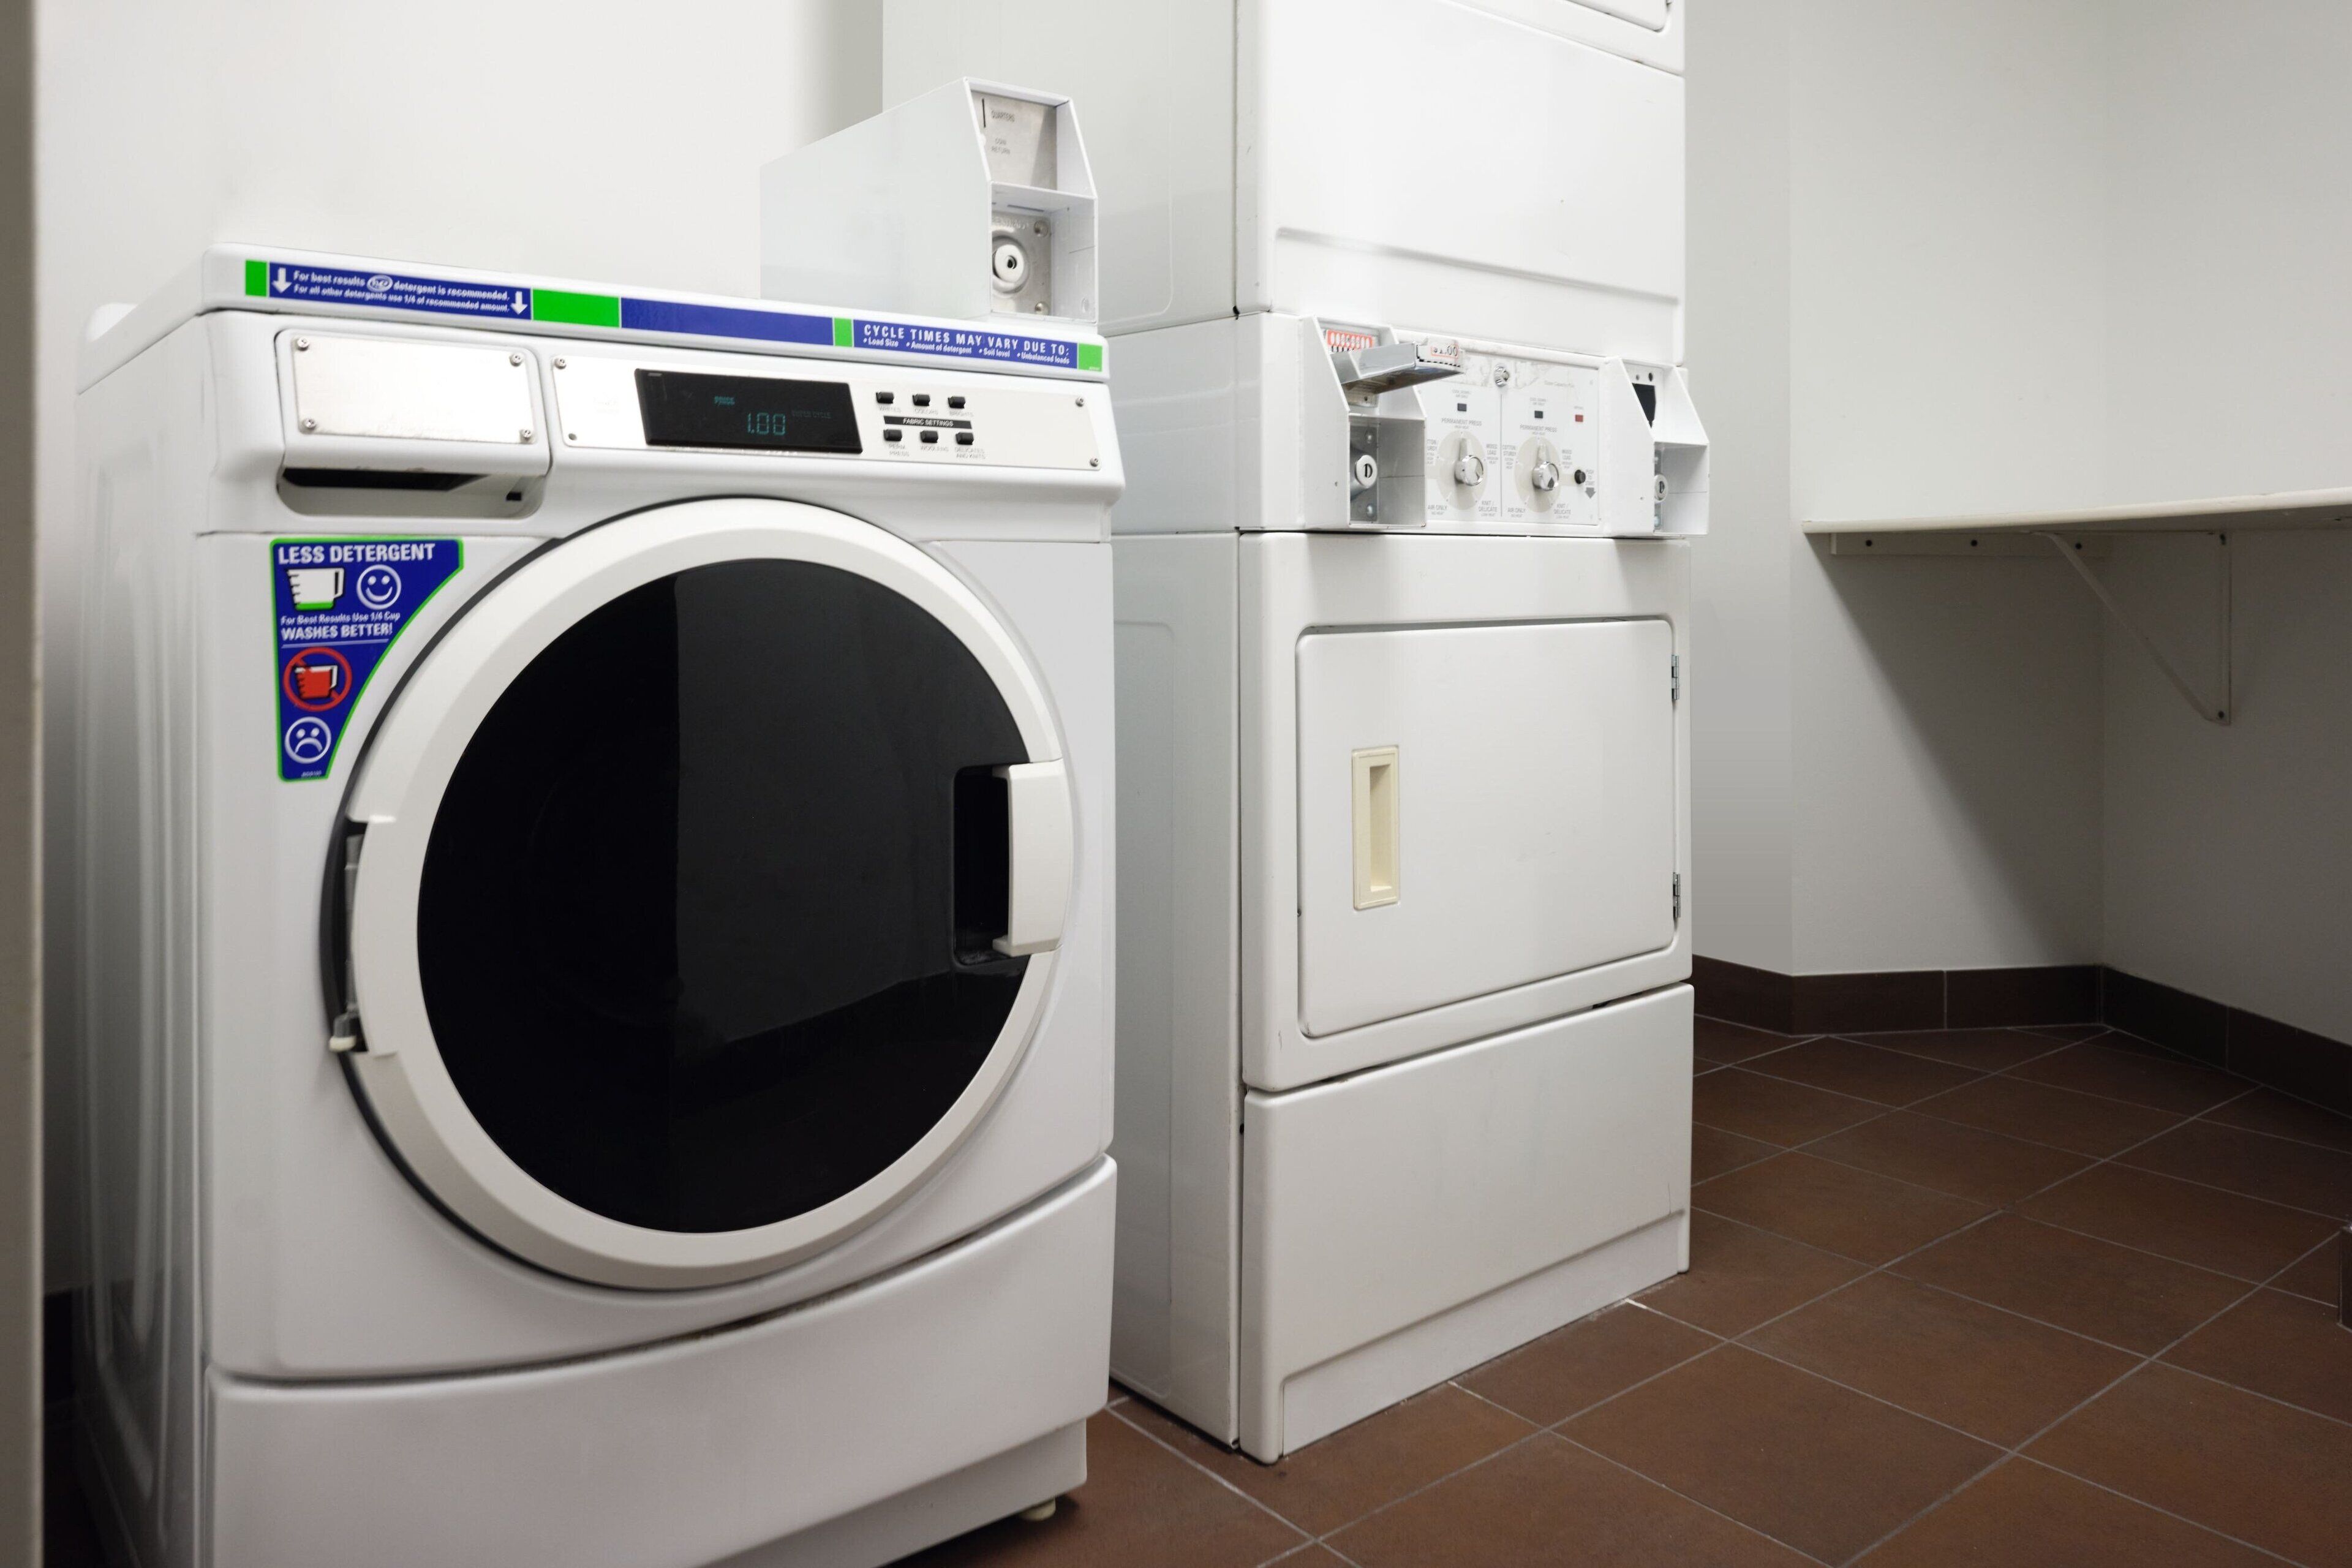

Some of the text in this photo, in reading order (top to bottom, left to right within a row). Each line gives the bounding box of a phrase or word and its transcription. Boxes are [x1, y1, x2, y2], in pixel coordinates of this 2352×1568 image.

[293, 270, 309, 282] For
[311, 271, 332, 284] best
[333, 275, 366, 287] results
[393, 281, 437, 295] detergent
[437, 285, 446, 295] is
[293, 284, 308, 294] For
[309, 285, 320, 295] all
[321, 287, 343, 297] other
[344, 288, 387, 301] detergents
[388, 293, 403, 303] use
[404, 294, 416, 304] 1/4
[416, 296, 426, 305] of
[426, 298, 480, 310] recommended
[864, 324, 905, 339] CYCLE
[910, 328, 950, 344] TIMES
[956, 333, 982, 347] MAY
[987, 336, 1019, 350] VARY
[1023, 340, 1046, 354] DUE
[868, 336, 899, 348] Load Size
[910, 341, 973, 355] Amount of detergent
[983, 347, 1011, 358] Soil level
[1021, 352, 1070, 365] Unbalanced loads
[747, 412, 786, 436] 1.00
[278, 543, 435, 565] LESS DETERGENT
[280, 611, 401, 626] For Best Results Use 1/4 Cup
[281, 622, 393, 641] WASHES BETTER!
